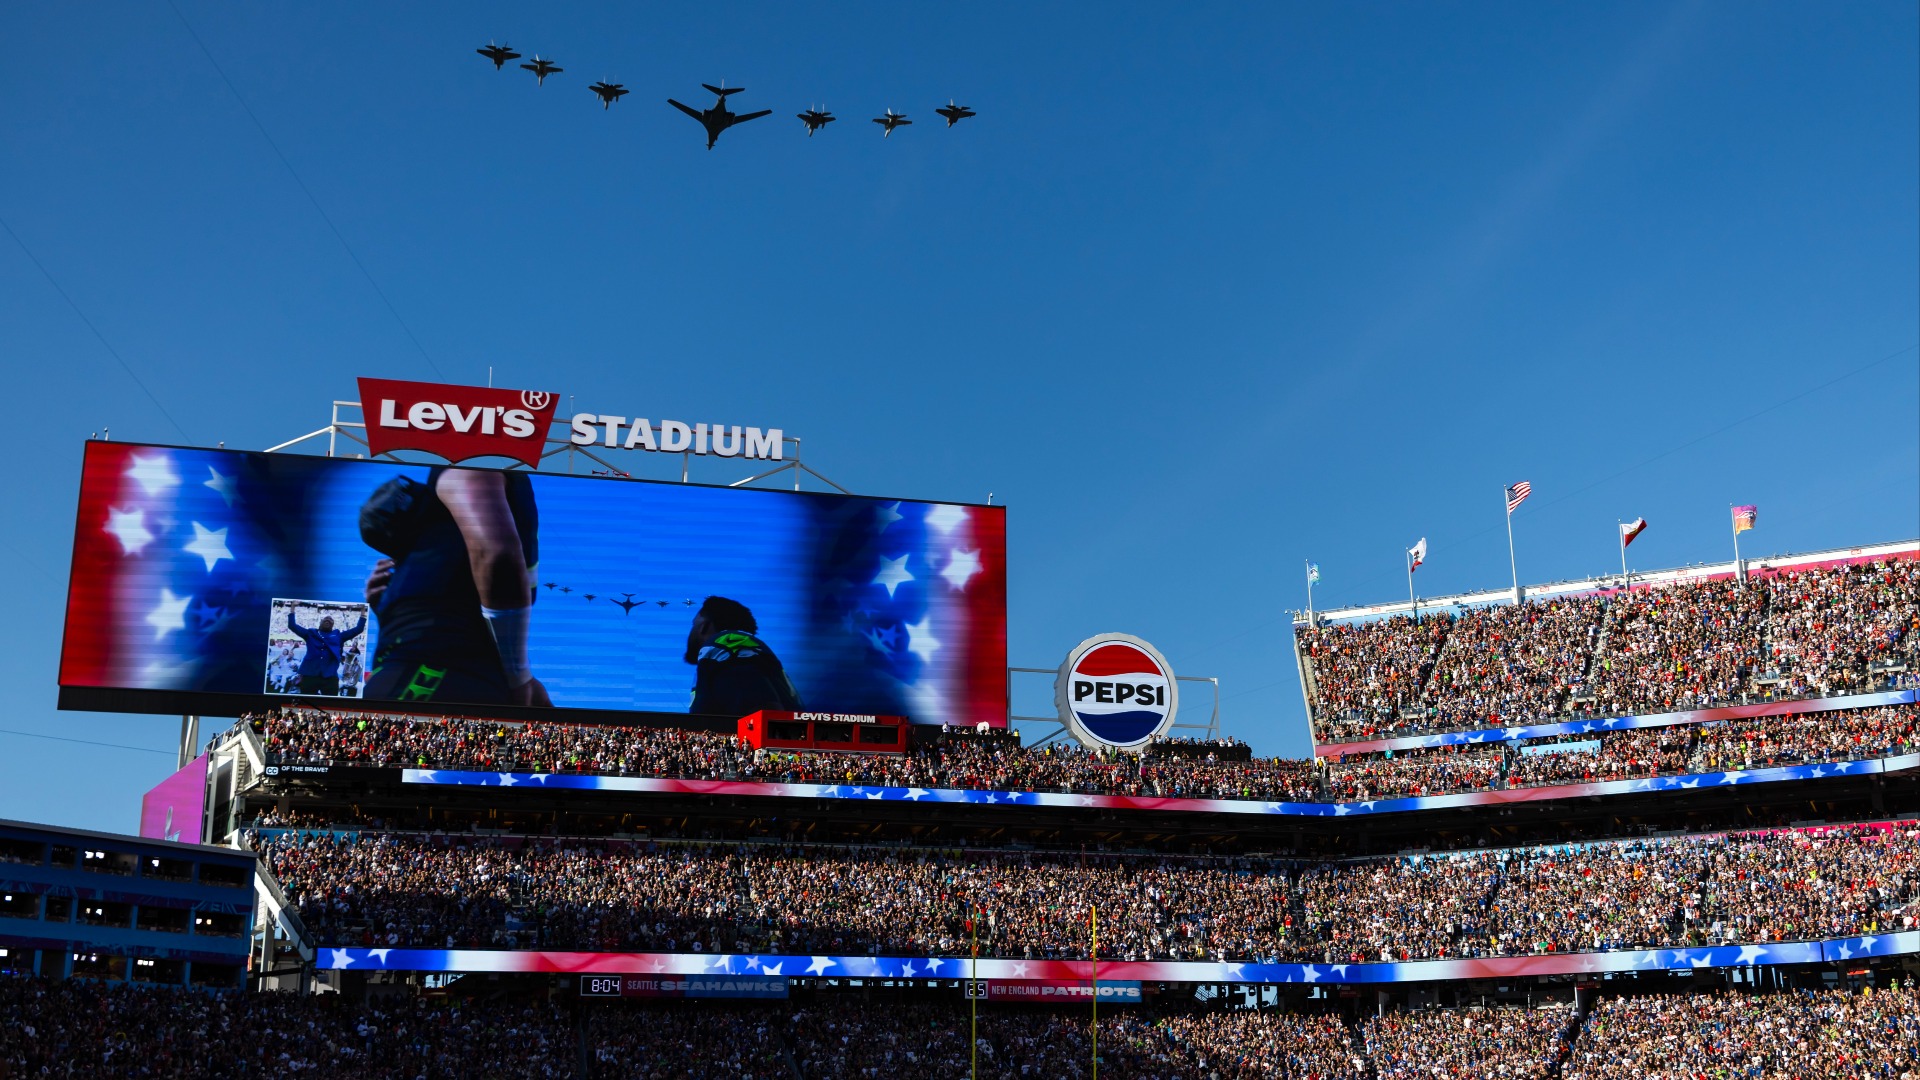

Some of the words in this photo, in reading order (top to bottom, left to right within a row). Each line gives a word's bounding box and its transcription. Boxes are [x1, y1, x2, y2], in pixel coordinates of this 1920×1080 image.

[571, 413, 783, 461] STADIUM
[1075, 681, 1164, 706] PEPSI
[832, 714, 876, 723] STADIUM
[591, 979, 620, 993] 8:04
[627, 981, 659, 990] SEATTLE
[660, 980, 785, 992] SEAHAWKS
[992, 986, 1007, 995] NEW
[1008, 986, 1039, 996] ENGLAND
[1041, 986, 1140, 996] PATRIOTS
